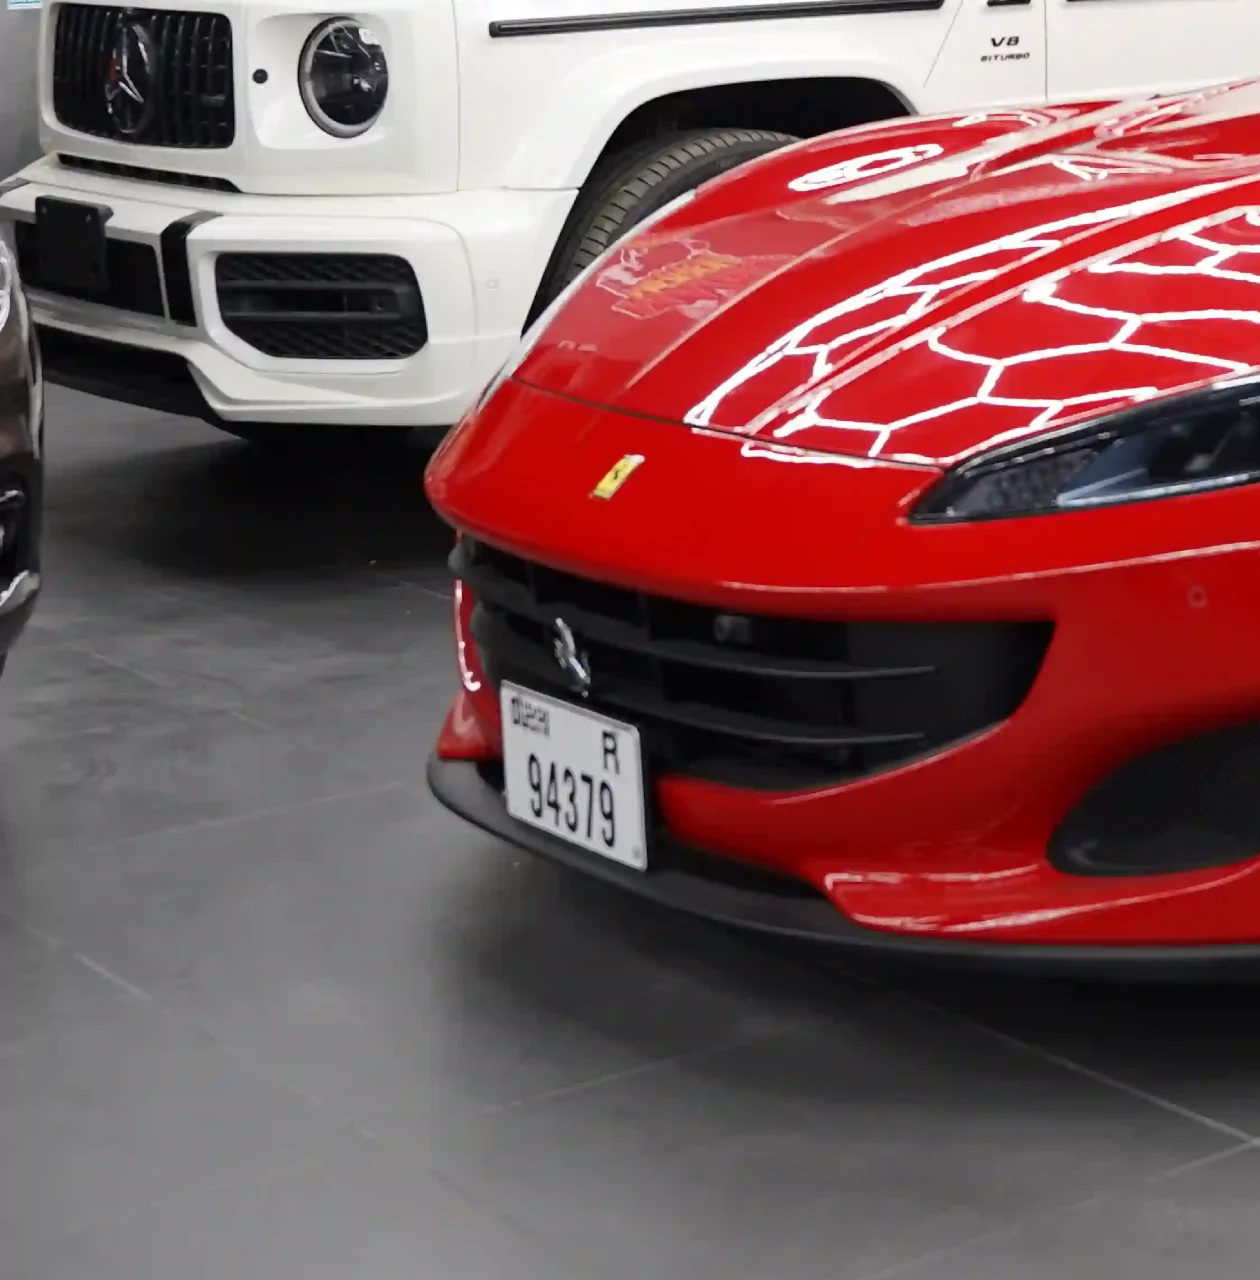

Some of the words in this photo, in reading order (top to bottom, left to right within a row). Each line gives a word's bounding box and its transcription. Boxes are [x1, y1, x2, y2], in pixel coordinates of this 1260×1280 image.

[990, 36, 1019, 47] V8
[980, 52, 1030, 62] BITURBO
[602, 730, 620, 774] R
[528, 753, 615, 847] 94379
